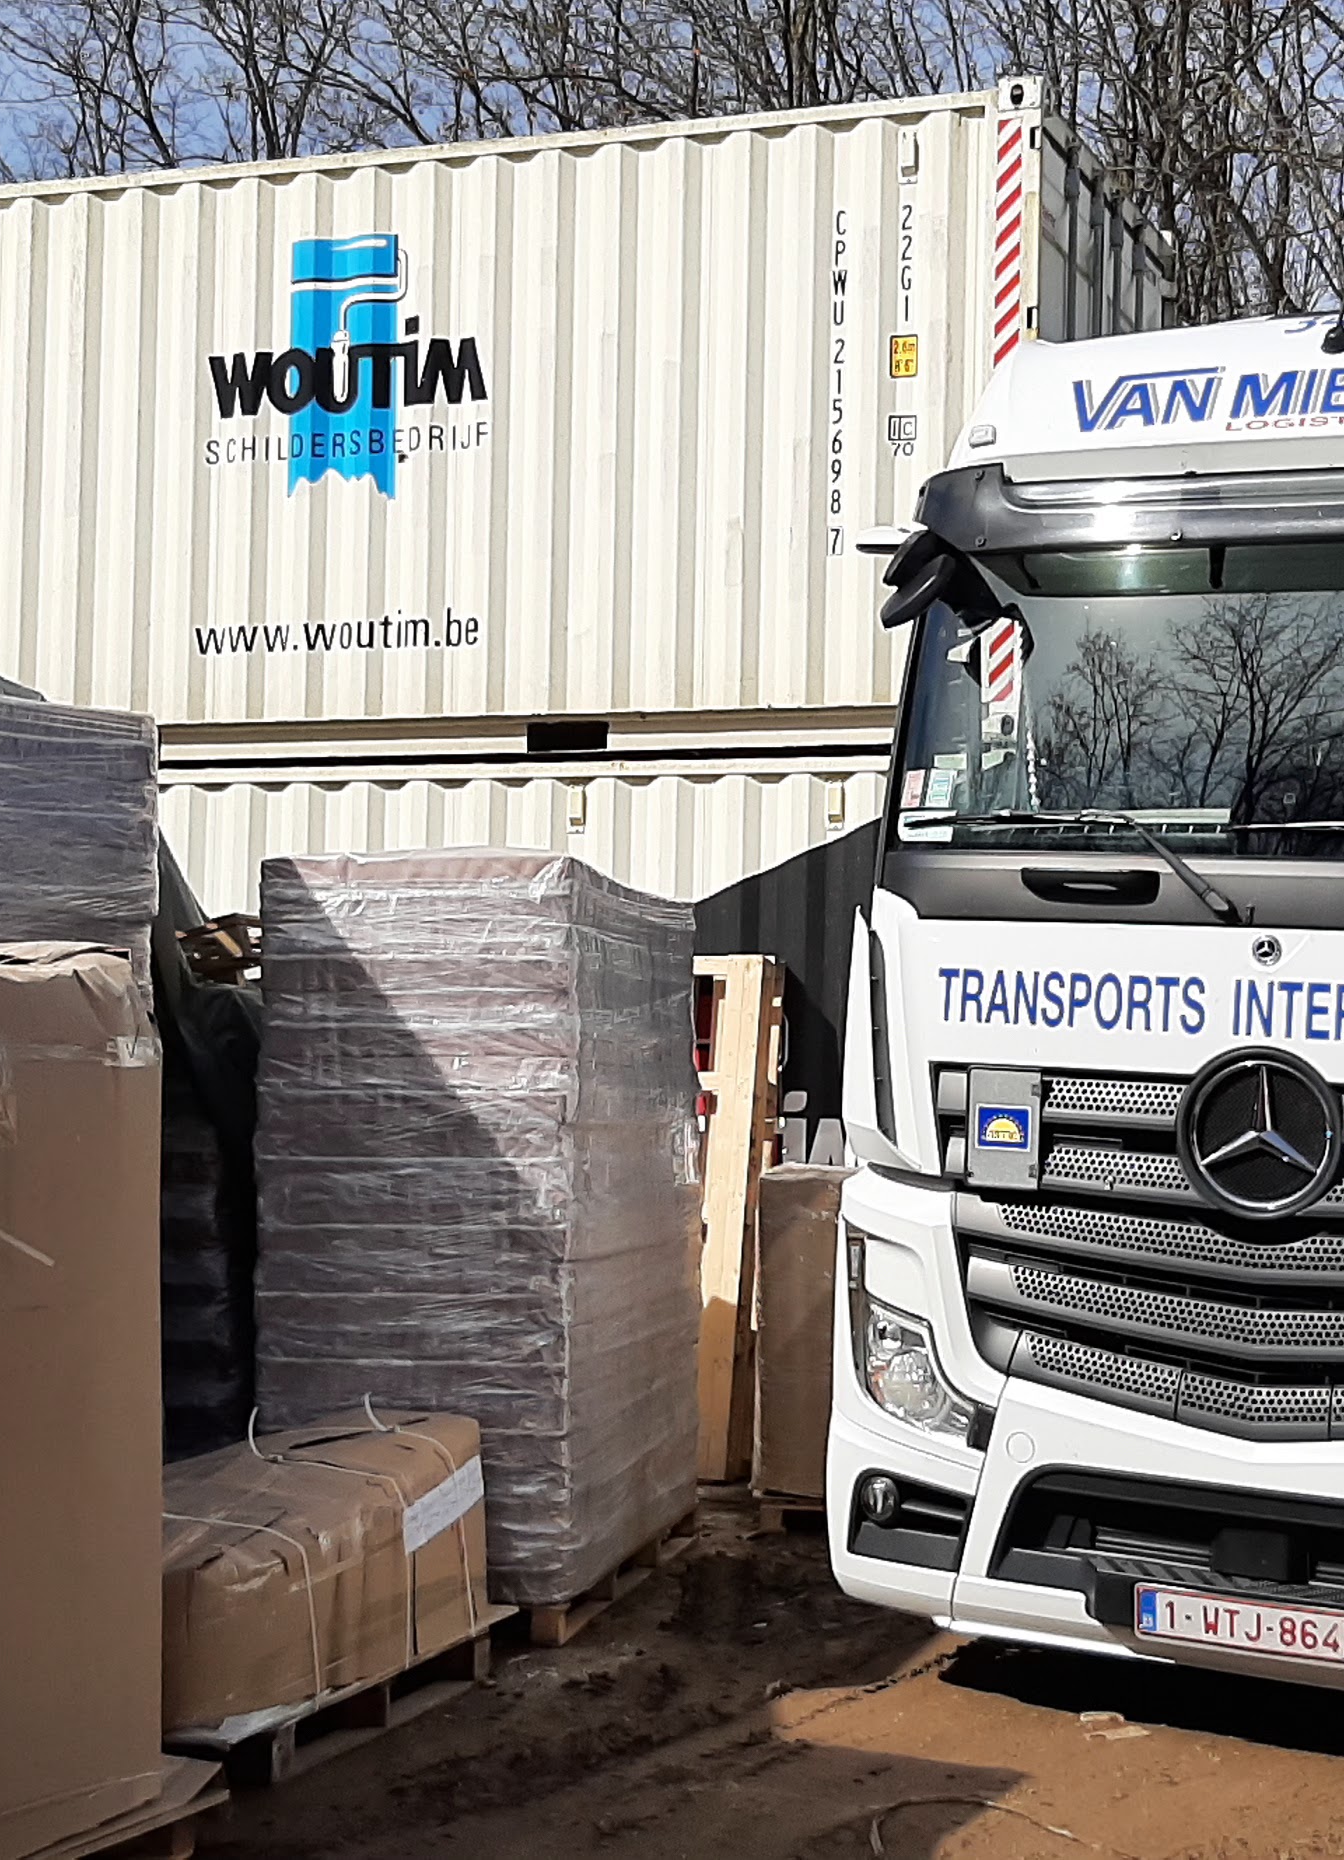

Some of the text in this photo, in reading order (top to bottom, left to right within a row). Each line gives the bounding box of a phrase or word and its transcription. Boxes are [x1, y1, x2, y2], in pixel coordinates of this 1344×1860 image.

[831, 211, 848, 326] CPWU
[830, 339, 845, 514] 215698
[1072, 365, 1226, 432] VAN
[205, 422, 489, 464] SCHILDERSBEDRIJF
[195, 608, 480, 656] www.woutim.be
[938, 967, 1206, 1036] TRANSPORTS
[1164, 1600, 1341, 1653] 1-WTJ-864
